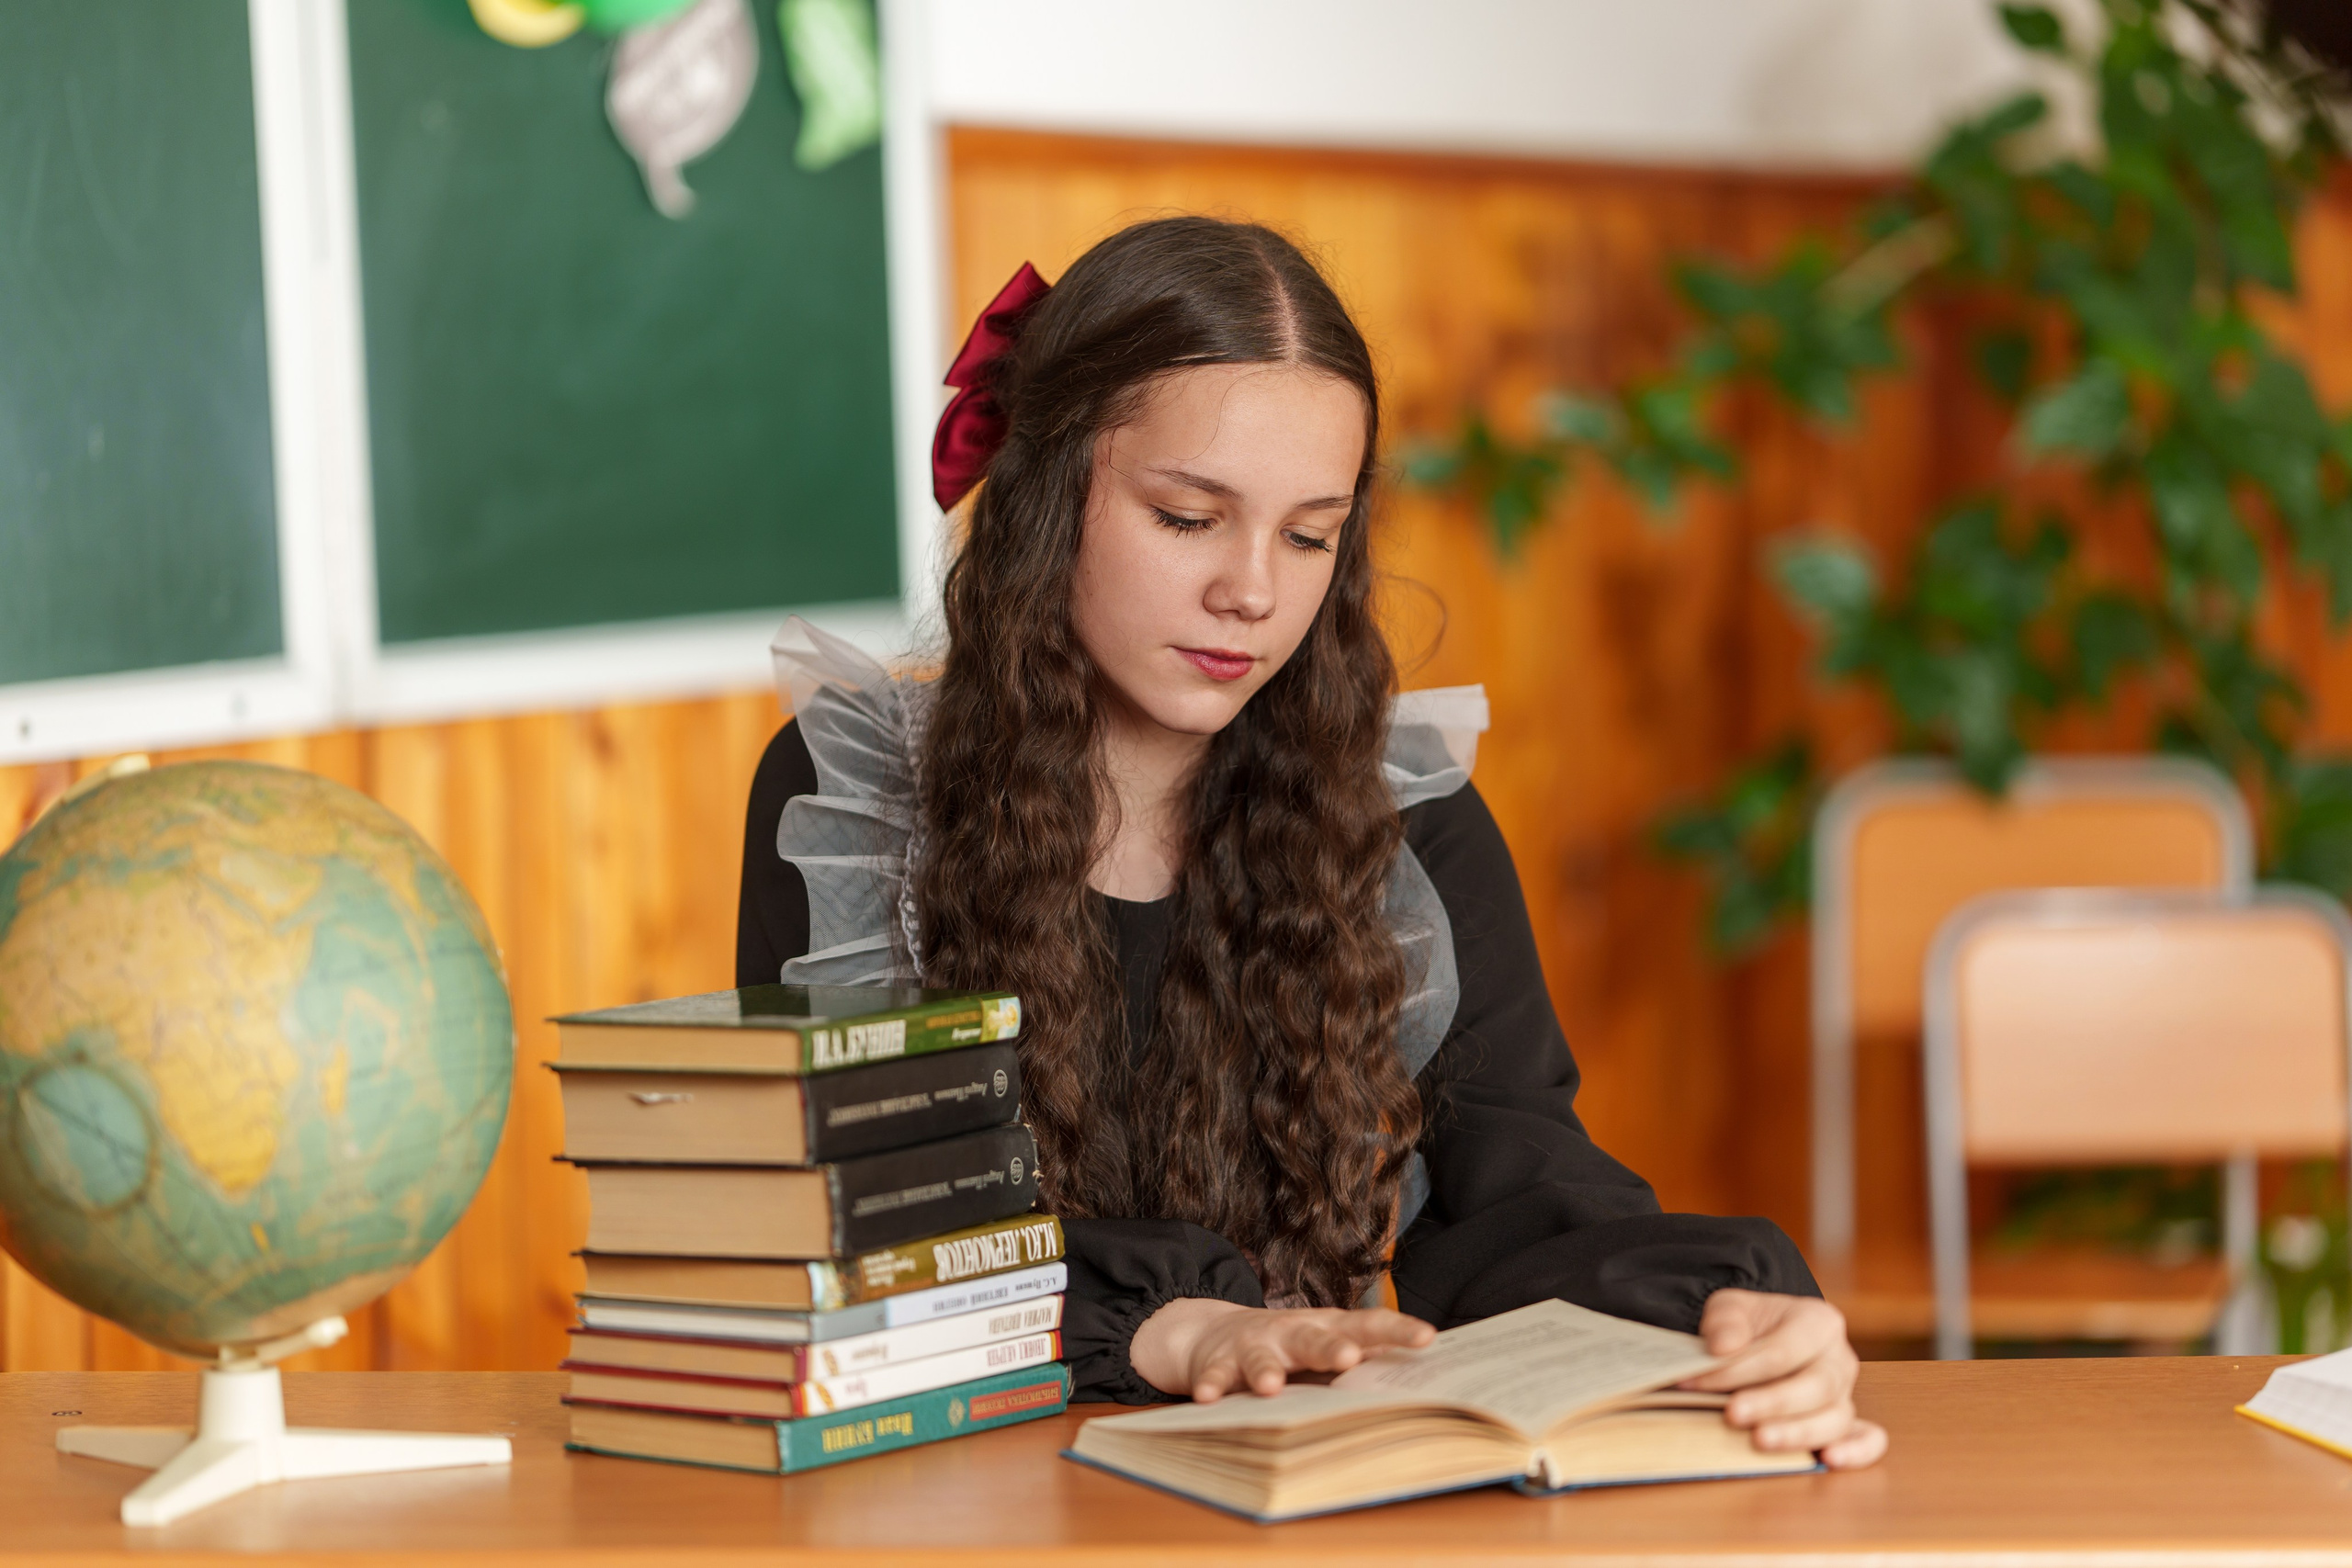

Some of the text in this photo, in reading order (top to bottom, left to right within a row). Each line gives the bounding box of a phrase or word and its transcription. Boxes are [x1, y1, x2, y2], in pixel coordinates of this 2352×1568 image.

[933, 1228, 1021, 1282] ЛЕРМОНТОВ
[1015, 1279, 1041, 1292] Пушкин
[1023, 1306, 1051, 1327] МАРИНА
[1007, 1387, 1057, 1407] БИБЛИОТЕКА
